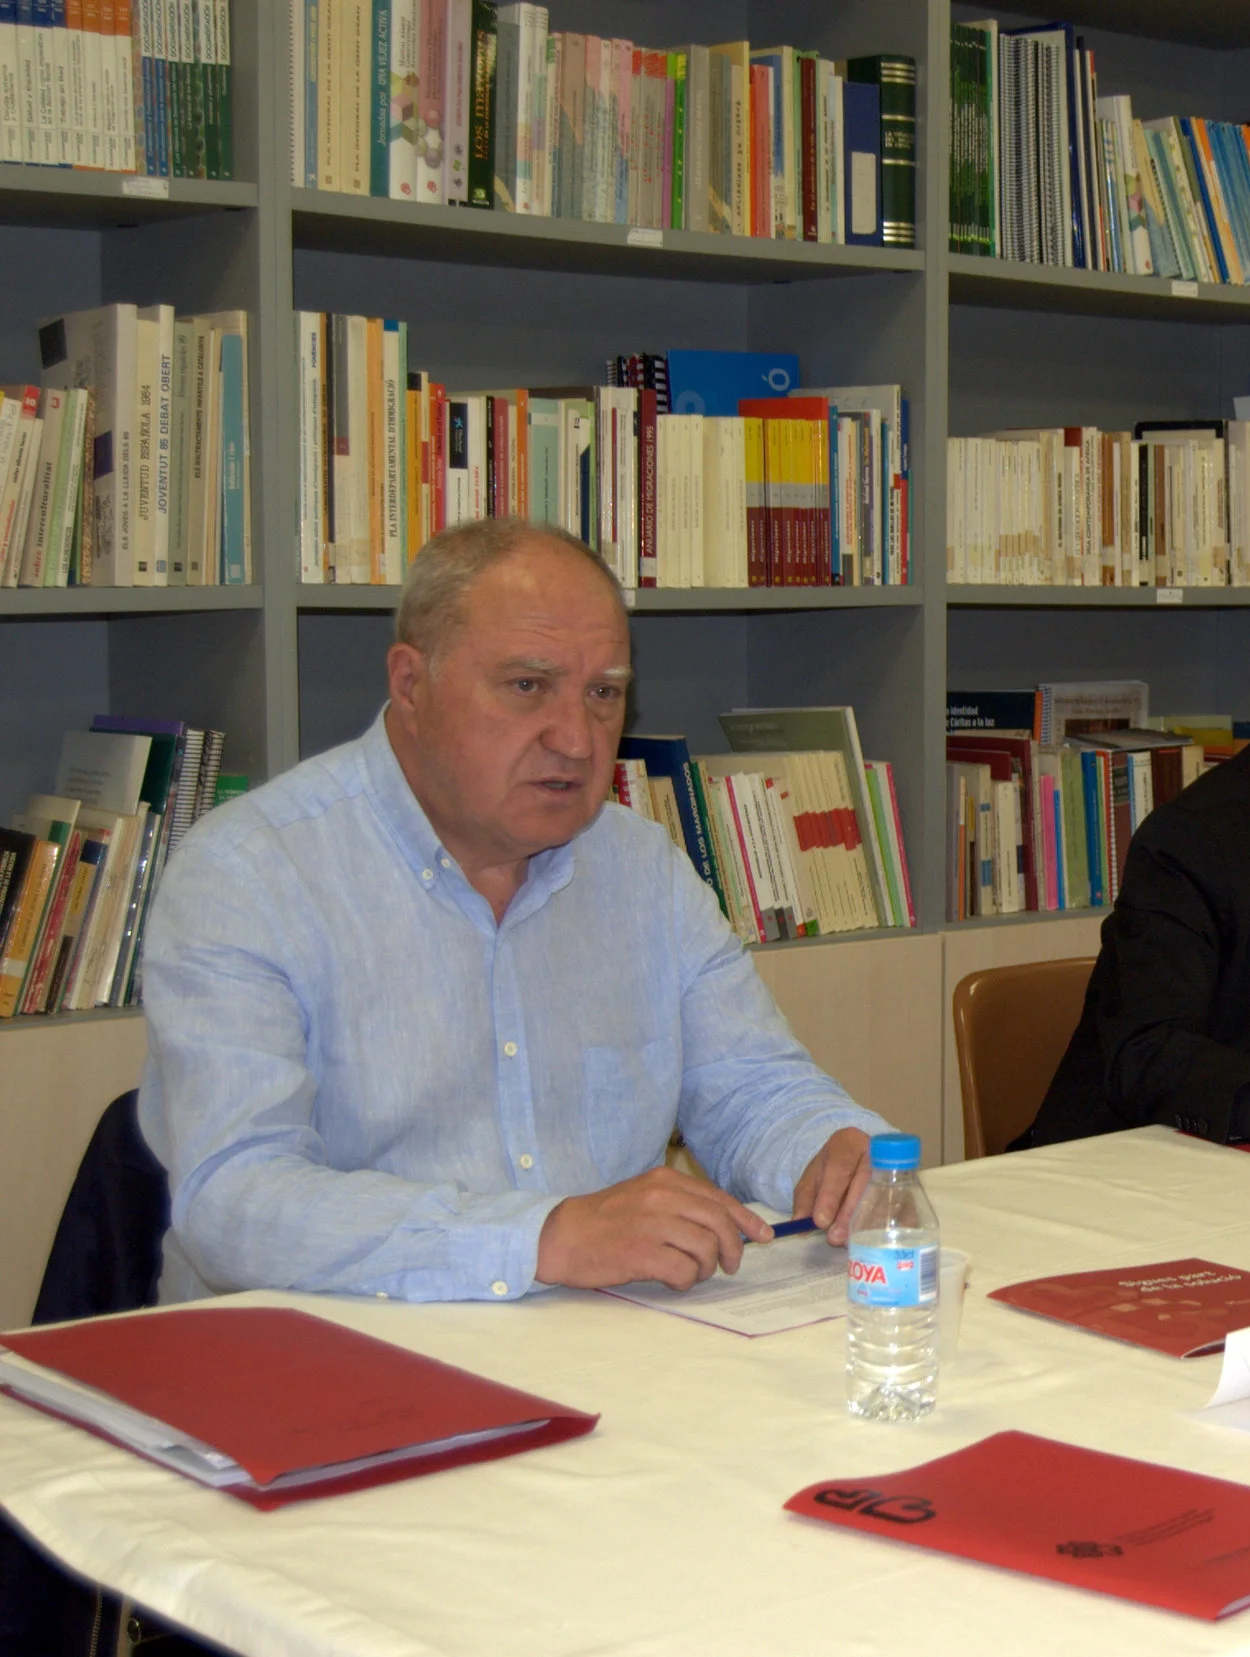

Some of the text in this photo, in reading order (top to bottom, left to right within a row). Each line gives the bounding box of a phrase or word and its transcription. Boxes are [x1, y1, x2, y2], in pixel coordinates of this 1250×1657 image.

[378, 9, 388, 40] ACTIVA
[377, 41, 387, 66] VEJEZ
[377, 107, 386, 146] Jornadas
[161, 354, 171, 392] OBERT
[160, 396, 170, 434] DEBAT
[139, 412, 151, 460] ESPAÑOLA
[385, 379, 398, 538] PLA INTERDEPARTAMENTAL D'IMMIGRACIÓ
[646, 445, 654, 501] MIGRACIONES
[139, 464, 150, 521] JUVENTUD
[158, 454, 169, 514] JOVENTUT
[35, 461, 53, 547] interculturalitat
[646, 502, 654, 513] DE
[646, 515, 655, 554] ANUARIO
[682, 762, 702, 834] MARGINADOS
[697, 836, 708, 858] LOS
[702, 860, 711, 875] DE
